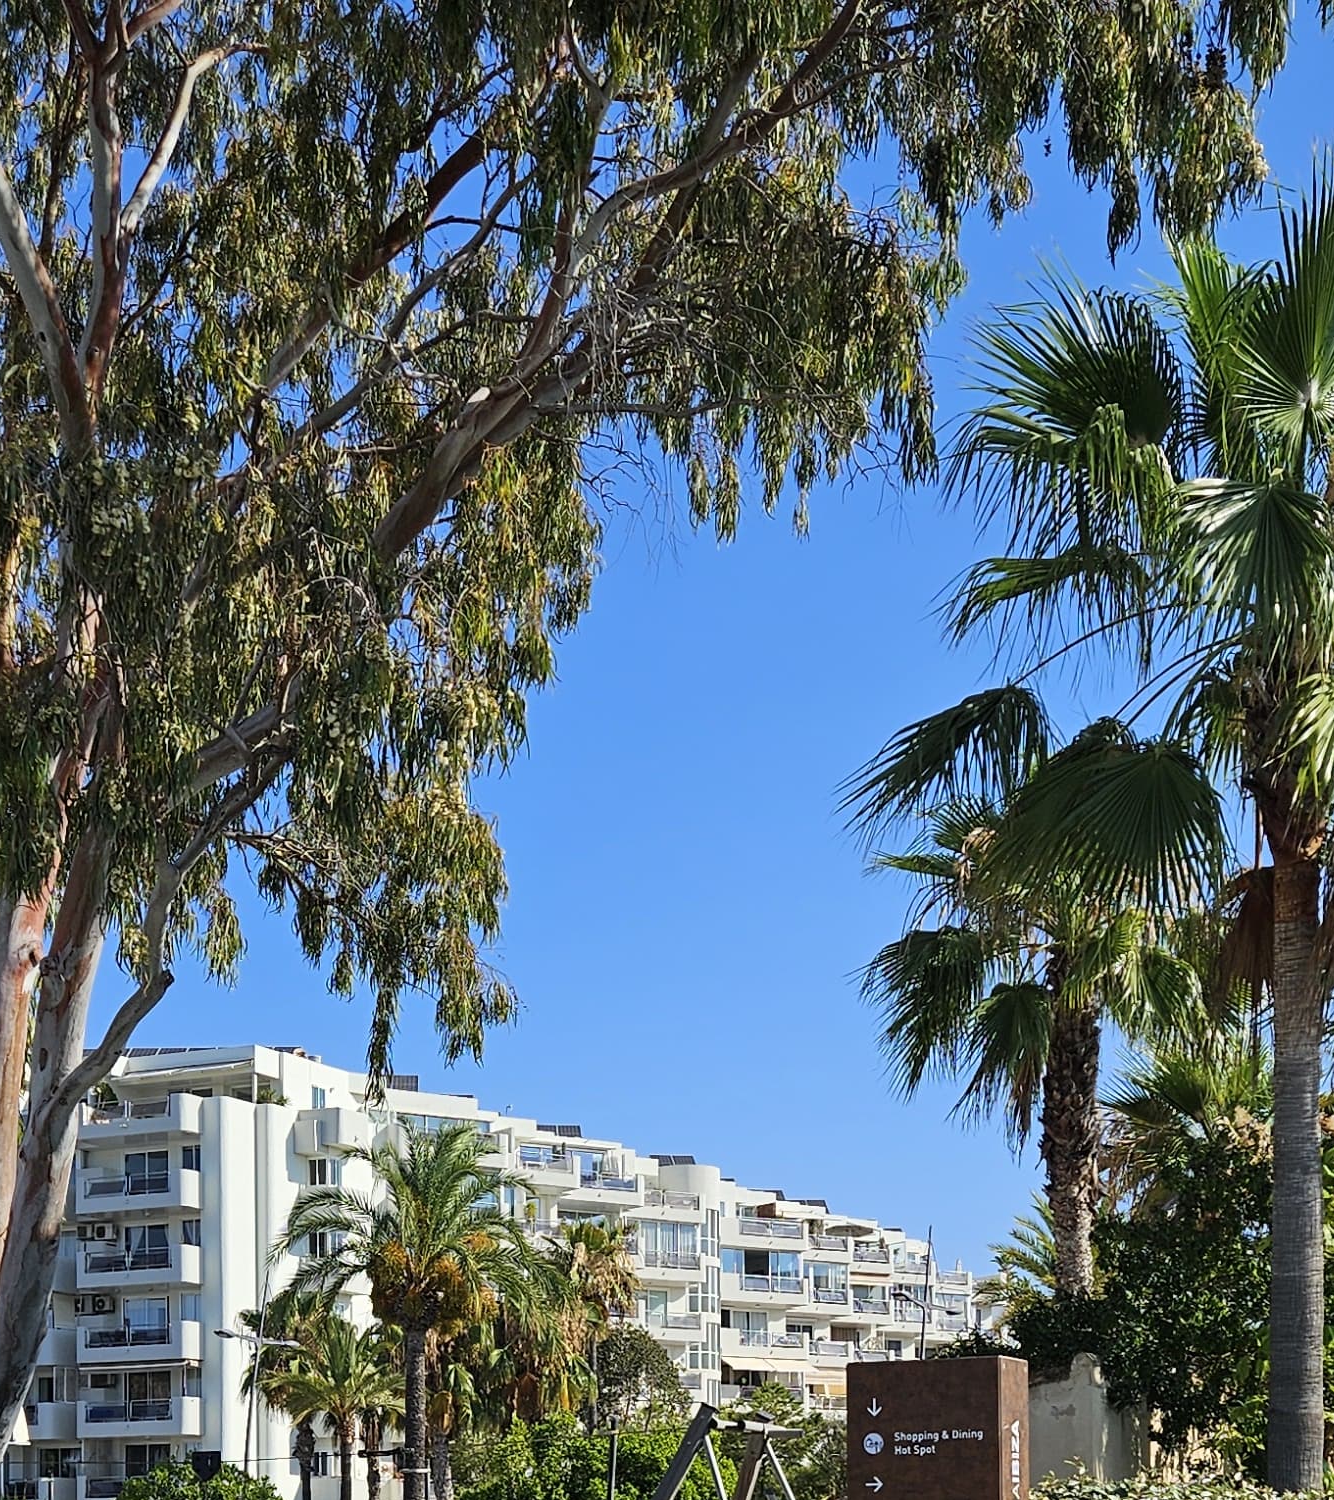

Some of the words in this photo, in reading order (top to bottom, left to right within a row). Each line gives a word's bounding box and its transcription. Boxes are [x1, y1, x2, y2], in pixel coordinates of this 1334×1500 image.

[894, 1430, 939, 1442] Shopping
[941, 1430, 949, 1440] &
[952, 1429, 984, 1441] Dining
[894, 1445, 912, 1455] Hot
[913, 1445, 936, 1456] Spot
